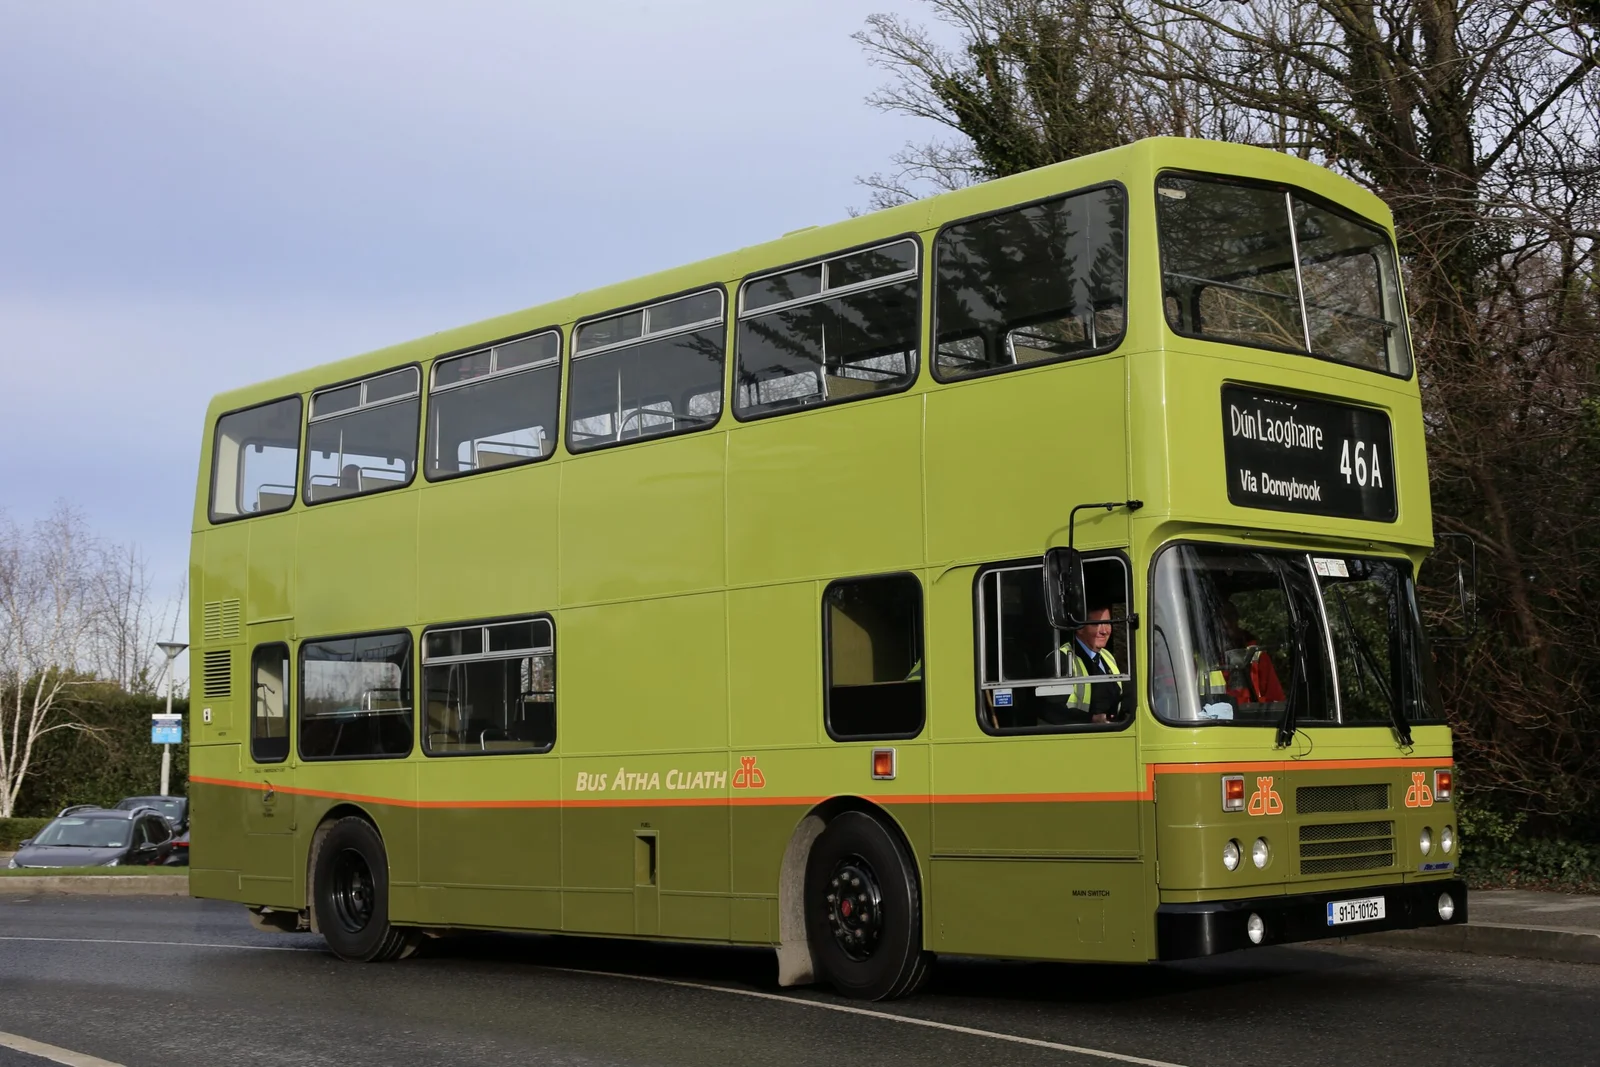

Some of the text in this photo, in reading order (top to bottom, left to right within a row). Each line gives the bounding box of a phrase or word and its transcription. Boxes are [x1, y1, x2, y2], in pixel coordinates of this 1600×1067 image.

[1231, 404, 1323, 450] Dún Laoghaire
[1340, 439, 1383, 488] 46A
[1240, 469, 1321, 501] Via Donnybrook
[576, 767, 727, 791] BUS ATHA CLIATH
[1339, 902, 1379, 922] 91-D-10125
